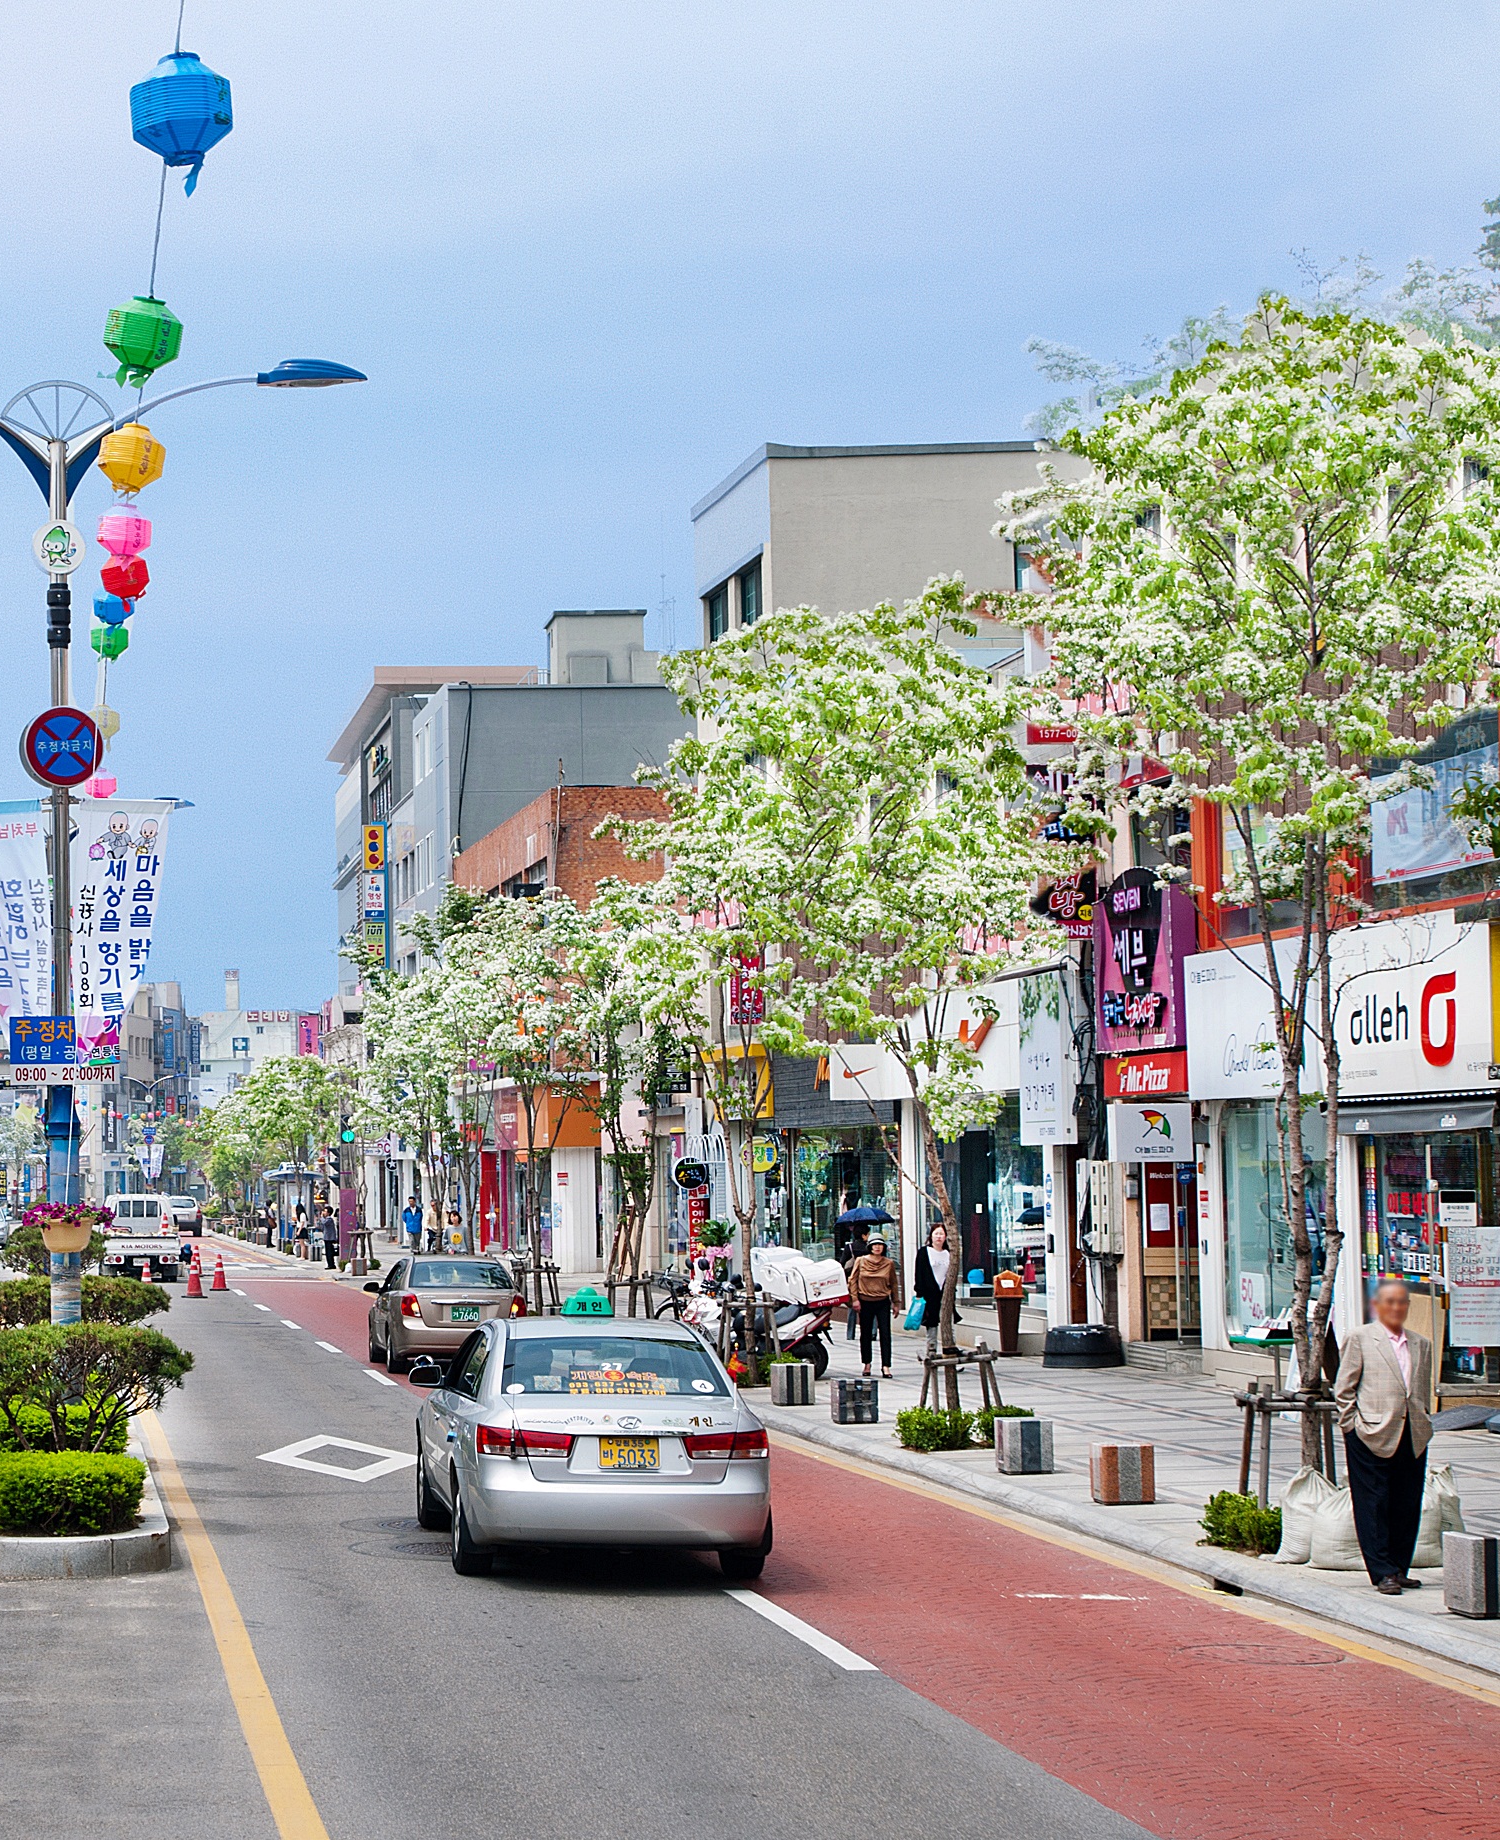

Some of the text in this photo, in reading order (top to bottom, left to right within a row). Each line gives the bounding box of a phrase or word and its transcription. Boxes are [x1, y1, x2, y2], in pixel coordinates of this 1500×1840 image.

[37, 739, 93, 753] 주정차금지
[99, 859, 128, 933] 세상을
[129, 854, 161, 928] 마음을
[1113, 886, 1141, 914] SEVEN
[1112, 928, 1147, 986] 세븐
[248, 1010, 289, 1022] 노래방
[1349, 991, 1409, 1046] olleh
[15, 1067, 47, 1082] 09:00
[1126, 1061, 1170, 1093] Mr.Pizza
[1149, 1172, 1174, 1180] Welcom
[576, 1301, 602, 1312] 개인
[460, 1312, 479, 1321] 7660
[601, 1362, 622, 1371] 27
[688, 1416, 714, 1428] 개인
[617, 1449, 658, 1466] 5033
